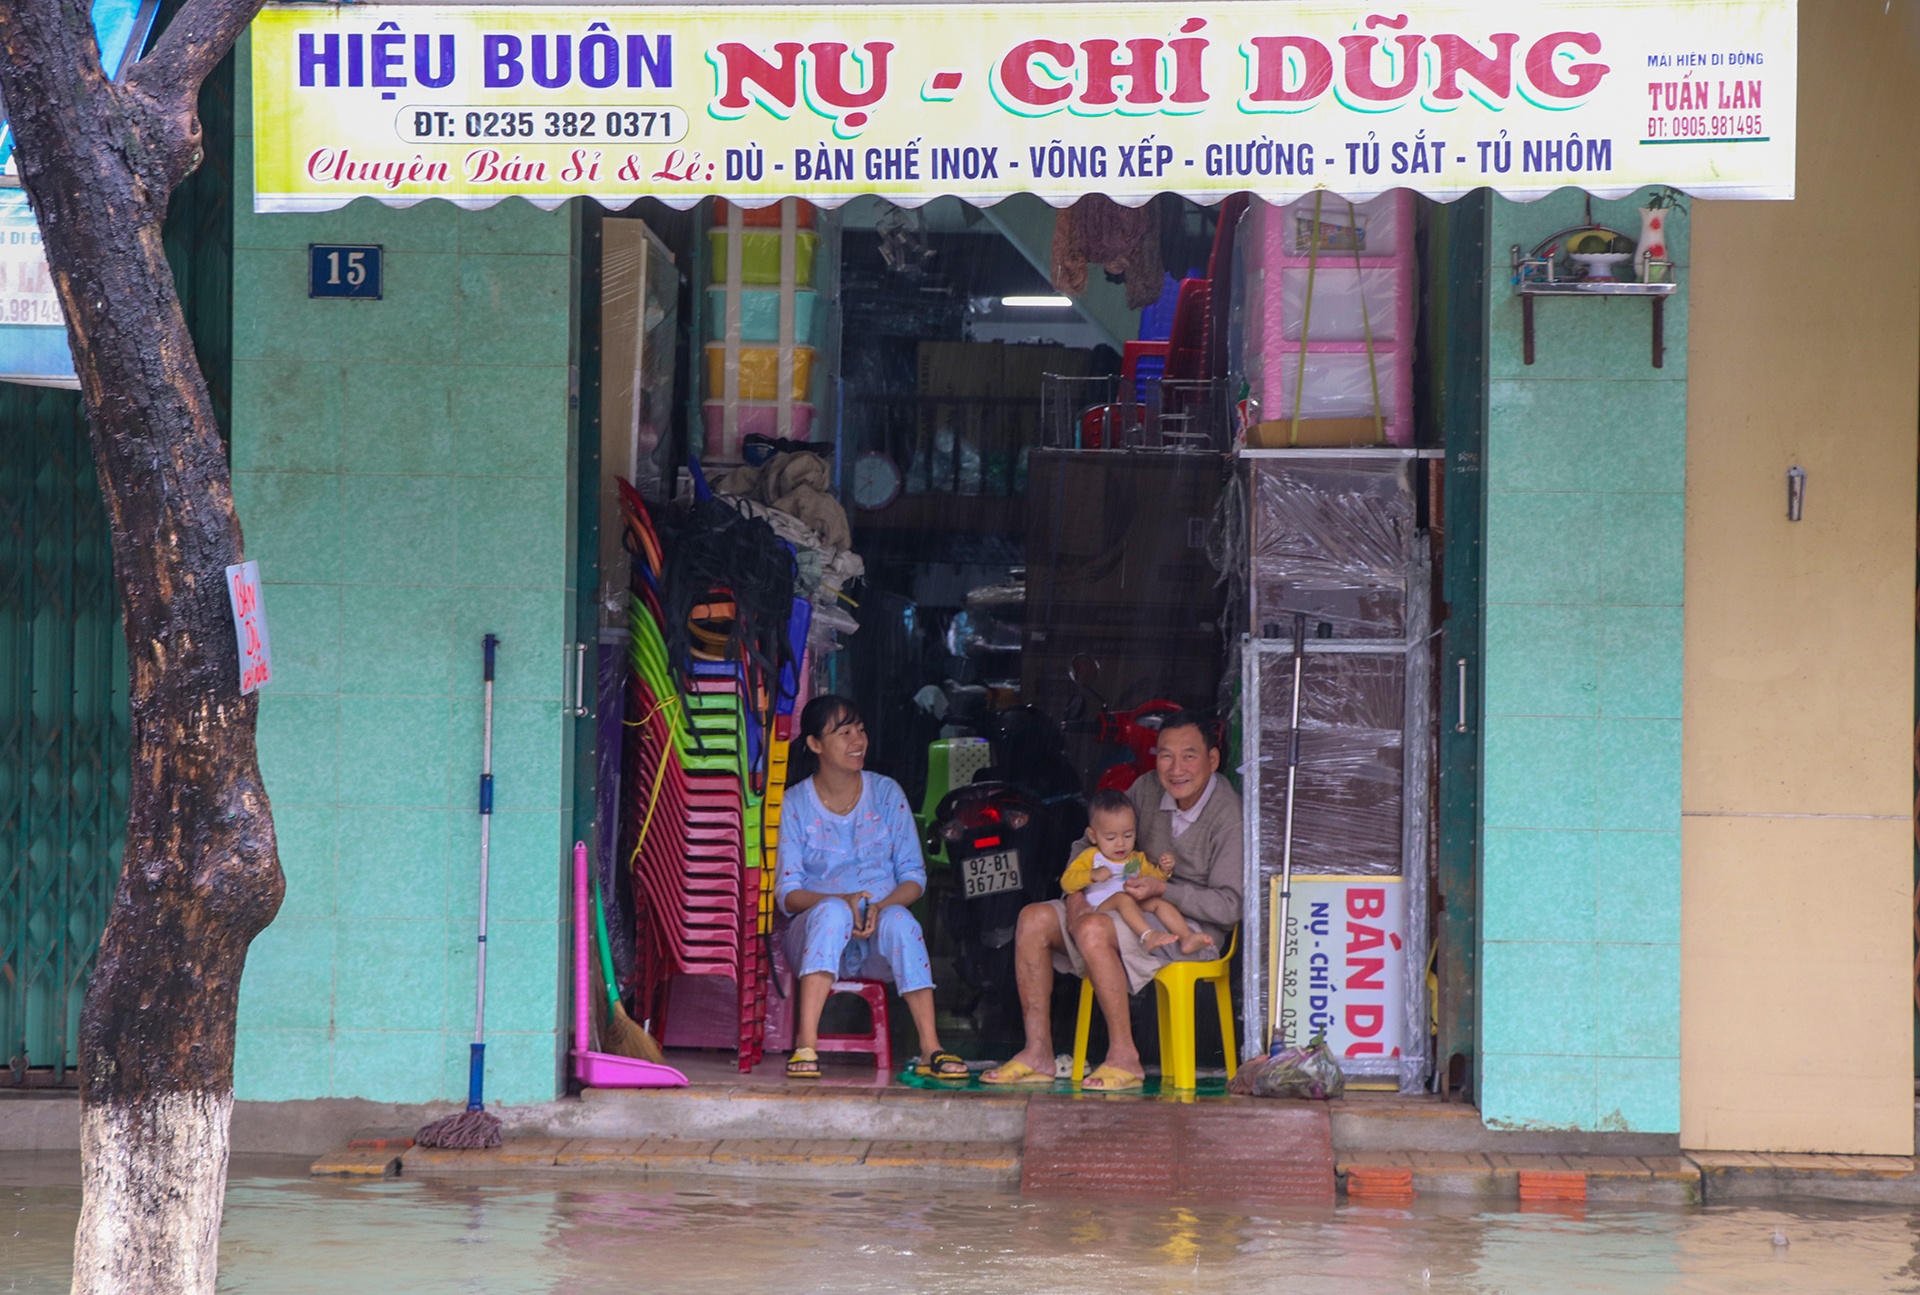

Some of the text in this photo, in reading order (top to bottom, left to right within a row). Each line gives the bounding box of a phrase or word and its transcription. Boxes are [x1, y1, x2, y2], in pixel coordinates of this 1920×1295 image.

[298, 21, 456, 101] HIỆU
[483, 21, 673, 90] BUÔN
[717, 42, 895, 128] NỤ
[1000, 17, 1211, 105] CHÍ
[1250, 13, 1611, 103] DŨNG
[1711, 53, 1724, 66] DI
[1728, 50, 1764, 68] ĐỘNG
[1648, 70, 1762, 111] TUẤN LAN
[413, 111, 671, 138] ĐT: 0235 382 0371
[1648, 115, 1762, 137] ĐT: 0905.981495
[307, 149, 449, 188] Chuyên
[465, 149, 547, 183] Bán
[617, 154, 640, 182] &
[726, 141, 764, 182] DÙ
[795, 141, 855, 181] BÀN
[865, 137, 922, 181] GHẾ
[931, 146, 999, 180] INOX
[1029, 140, 1107, 179] VÕNG
[1118, 134, 1174, 177] XẾP
[1205, 135, 1314, 177] GIƯỜNG
[1345, 130, 1380, 175] TỦ
[1391, 128, 1447, 175] SẮT
[1476, 129, 1512, 174] TỦ
[1523, 131, 1613, 173] NHÔM
[10, 231, 25, 245] DI
[327, 251, 367, 285] 15
[969, 853, 1010, 877] 92-B1
[966, 870, 1019, 895] 367.79
[1303, 902, 1330, 936] NỤ
[1345, 887, 1403, 991] BÁN
[1282, 917, 1299, 1046] 0235 382 0371
[1309, 951, 1338, 993] CHÍ
